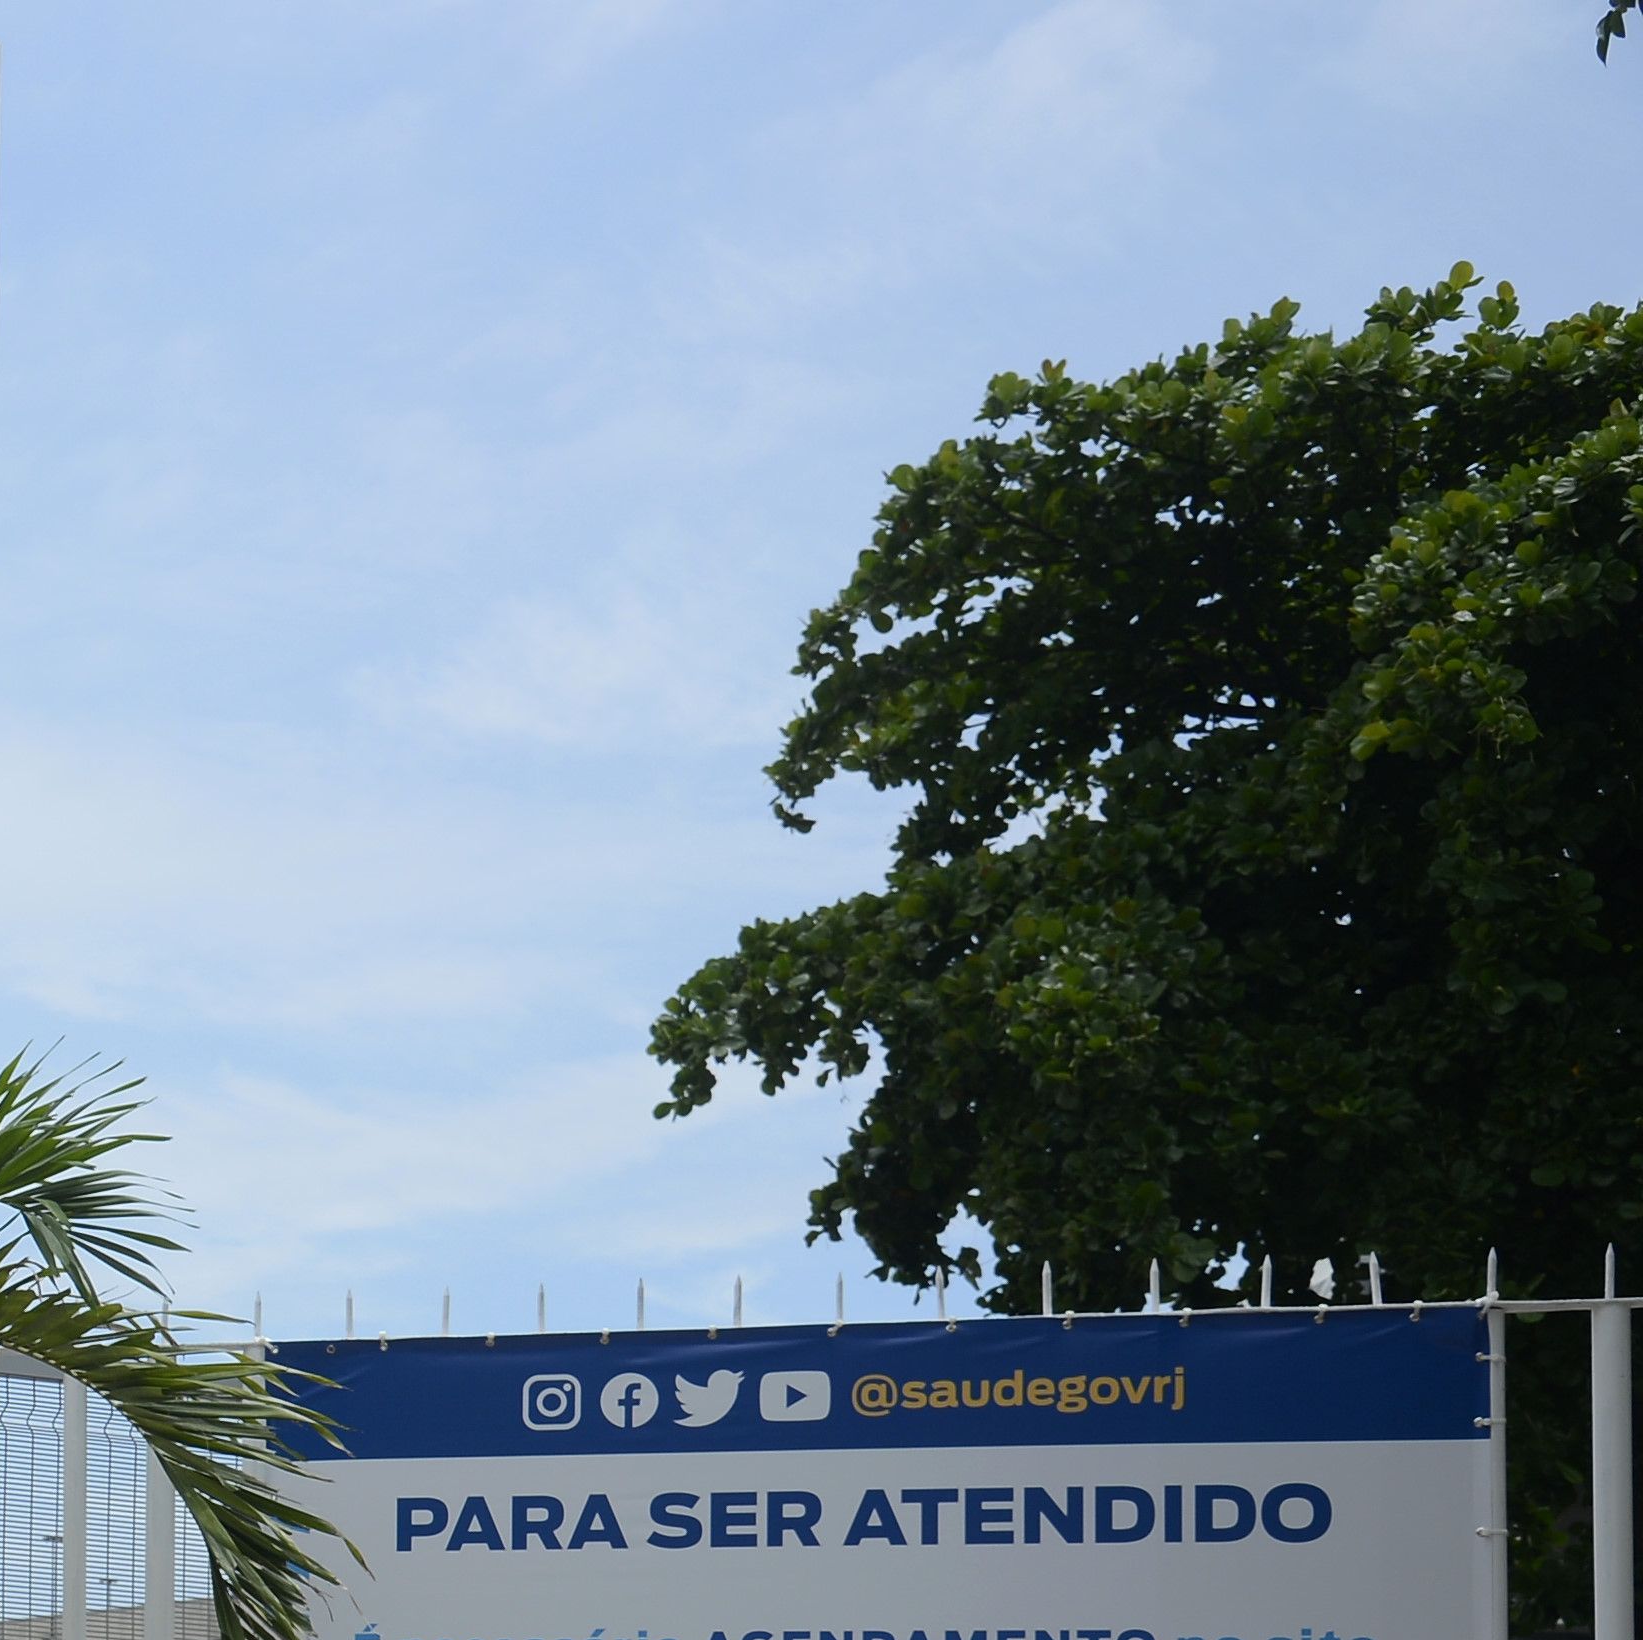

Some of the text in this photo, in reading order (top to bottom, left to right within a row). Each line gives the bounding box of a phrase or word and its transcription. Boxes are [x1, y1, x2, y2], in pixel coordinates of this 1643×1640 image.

[852, 1367, 1184, 1416] @saudegovrj
[396, 1483, 1332, 1551] PARA SER ATENDIDO
